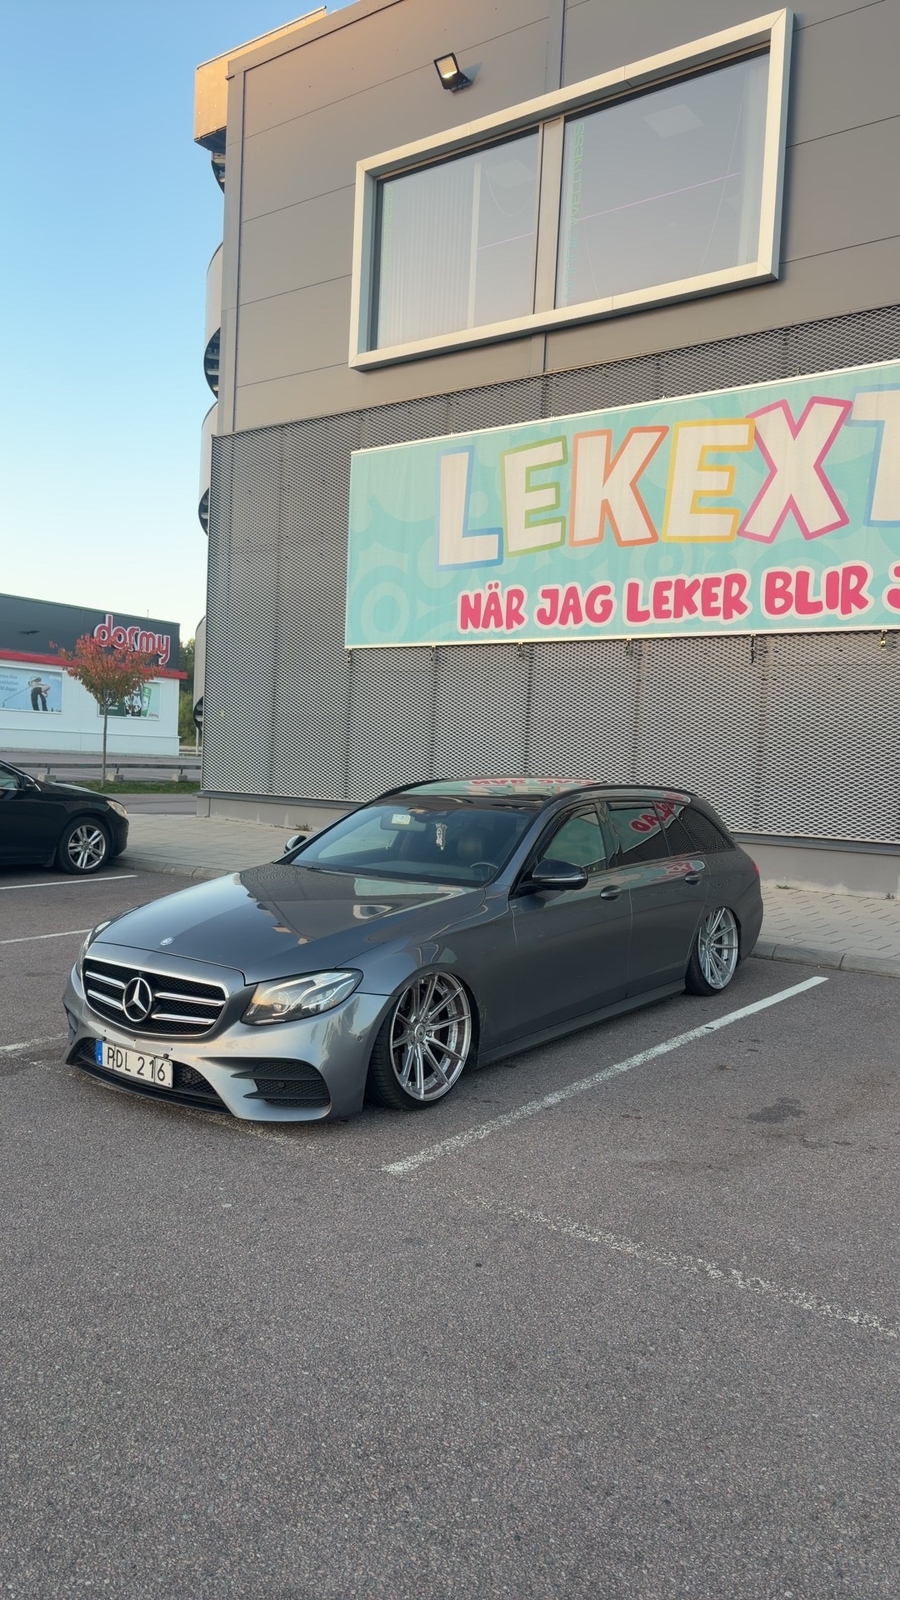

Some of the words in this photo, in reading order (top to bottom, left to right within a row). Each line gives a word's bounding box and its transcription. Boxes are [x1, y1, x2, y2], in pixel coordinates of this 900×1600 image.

[570, 122, 585, 227] WELLNESS
[460, 583, 525, 630] NÄR
[536, 585, 614, 626] JAG
[626, 574, 748, 623] LEKER
[764, 565, 869, 616] BLIR
[94, 614, 170, 665] dormy
[137, 1056, 166, 1081] 216
